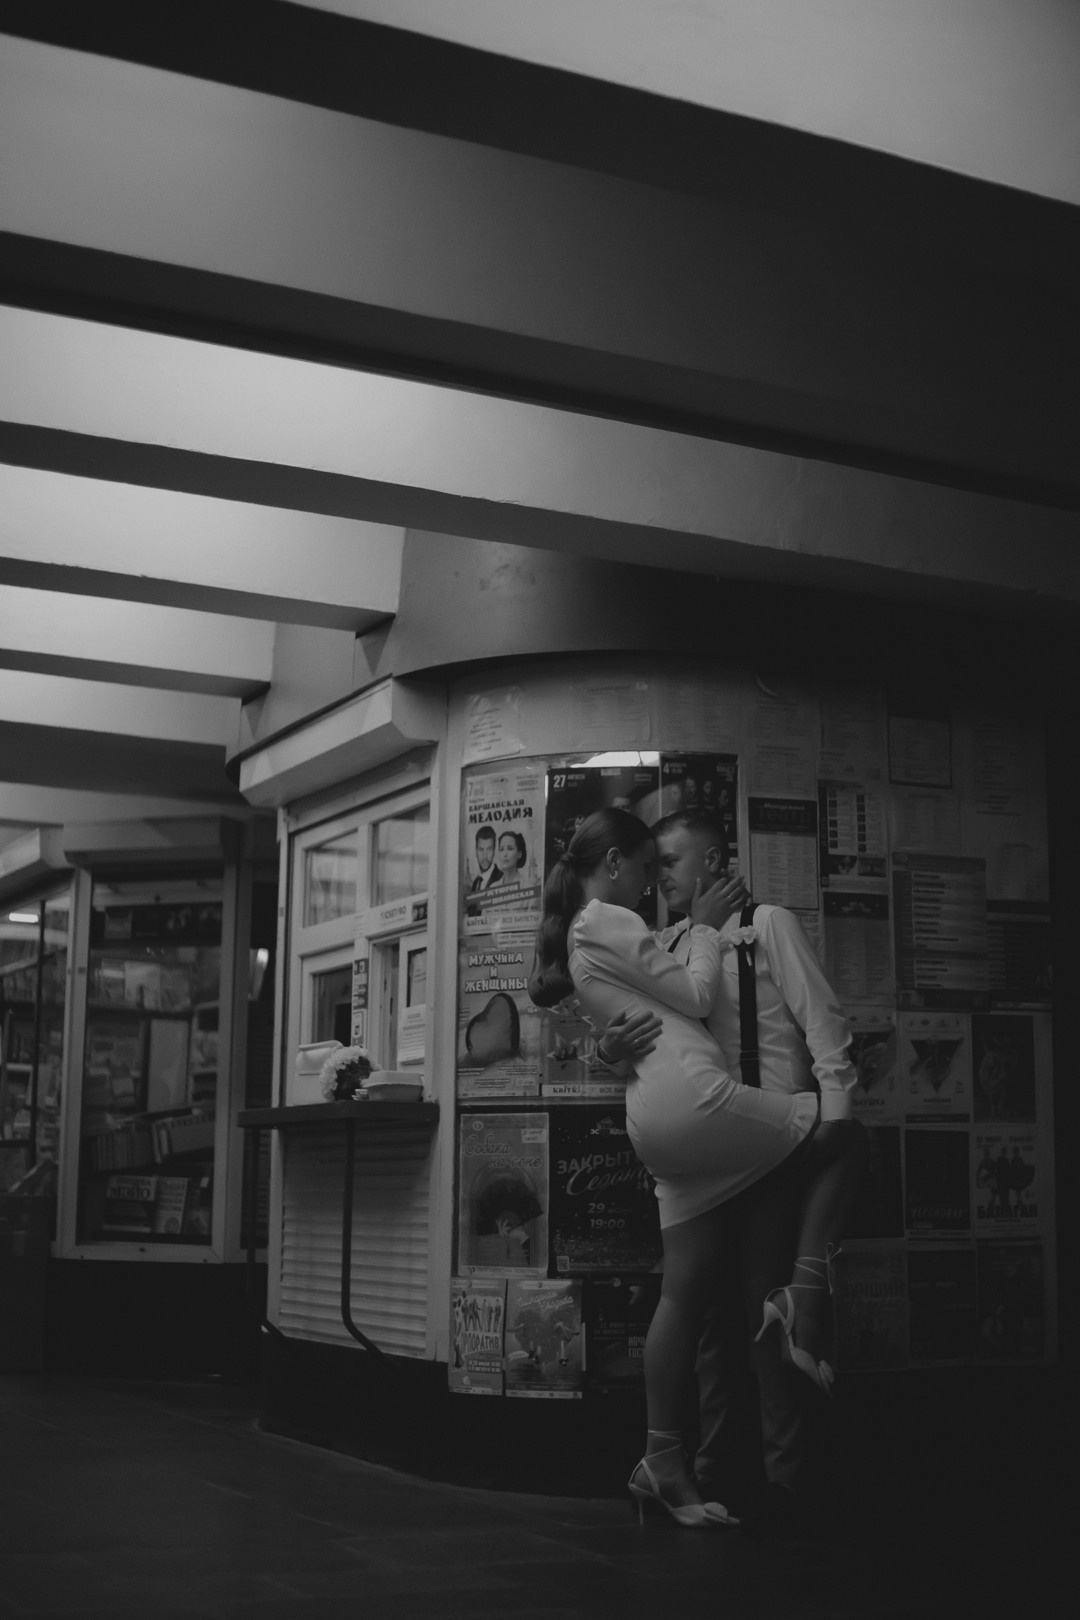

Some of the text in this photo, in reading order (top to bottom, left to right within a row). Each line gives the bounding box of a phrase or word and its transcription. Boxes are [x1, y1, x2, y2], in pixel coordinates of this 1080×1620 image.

[552, 774, 566, 788] 27
[468, 799, 525, 813] ВАРШАВСКАЯ
[468, 806, 533, 824] МЕЛОДИЯ
[468, 952, 524, 967] МУЖЧИНА
[489, 966, 498, 979] И
[465, 977, 529, 993] ЖЕНЩИНЫ
[557, 1150, 636, 1174] ЗАКРЫТ
[586, 1202, 605, 1214] 29
[590, 1218, 626, 1229] 19:00
